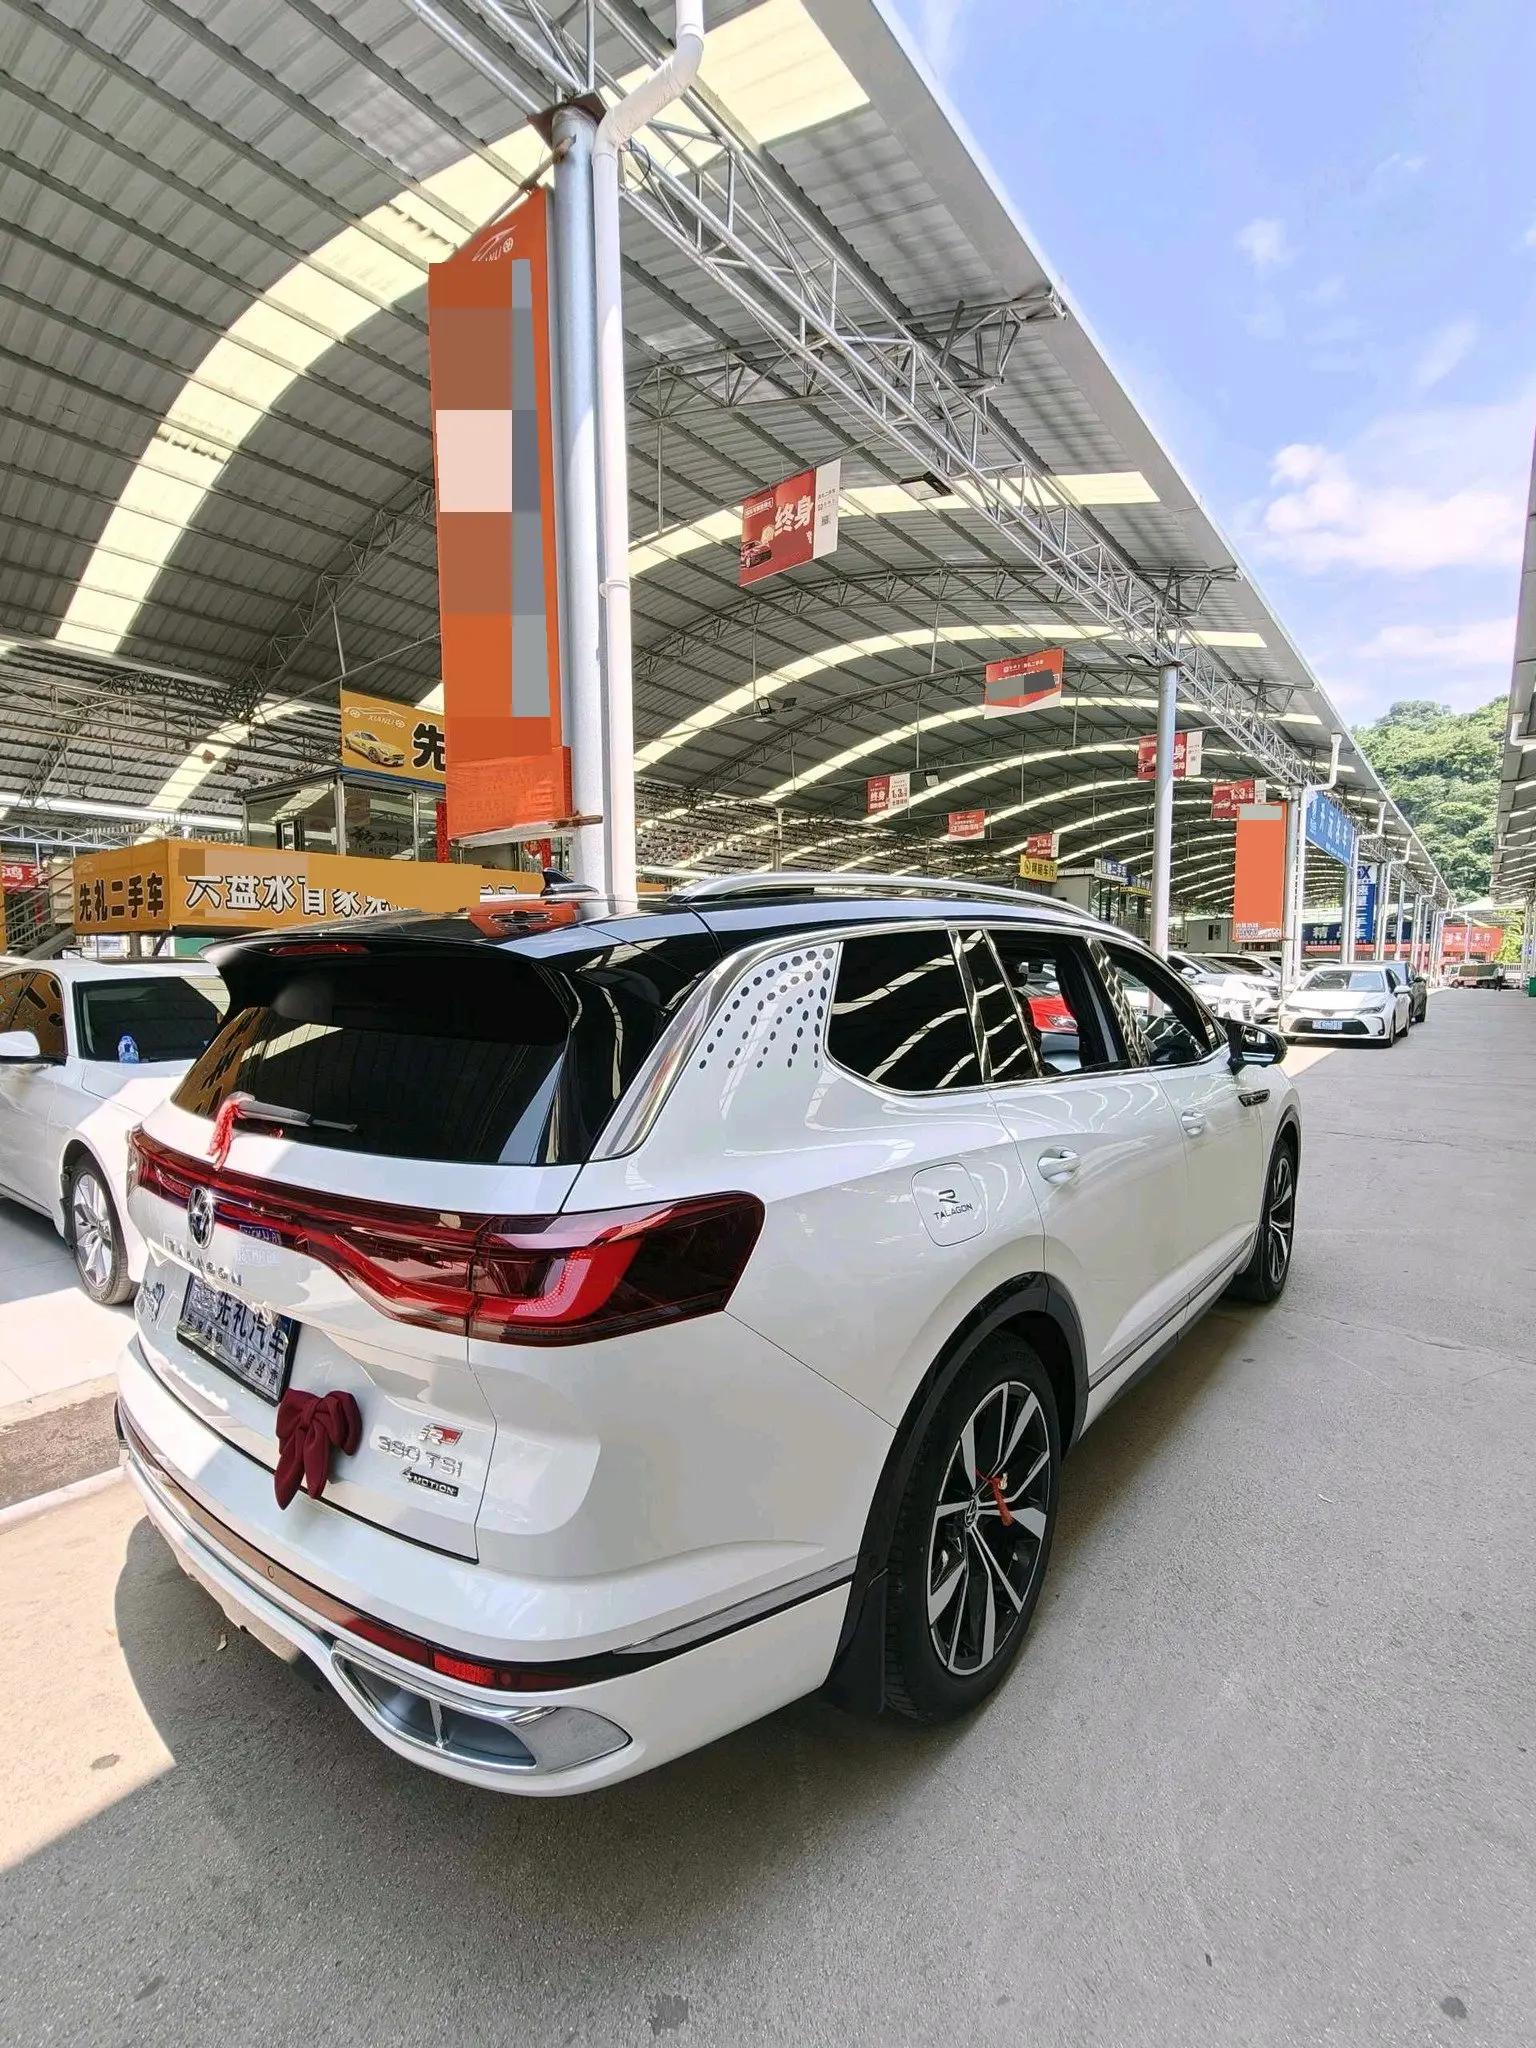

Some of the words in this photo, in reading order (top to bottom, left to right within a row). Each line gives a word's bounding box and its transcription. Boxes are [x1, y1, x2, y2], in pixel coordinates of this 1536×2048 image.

[774, 495, 814, 537] 终身
[79, 872, 164, 922] 先礼二手车
[933, 1203, 974, 1220] TALAGON
[378, 1435, 421, 1463] 380
[425, 1451, 463, 1478] TSI
[401, 1466, 457, 1497] 4MOTION
